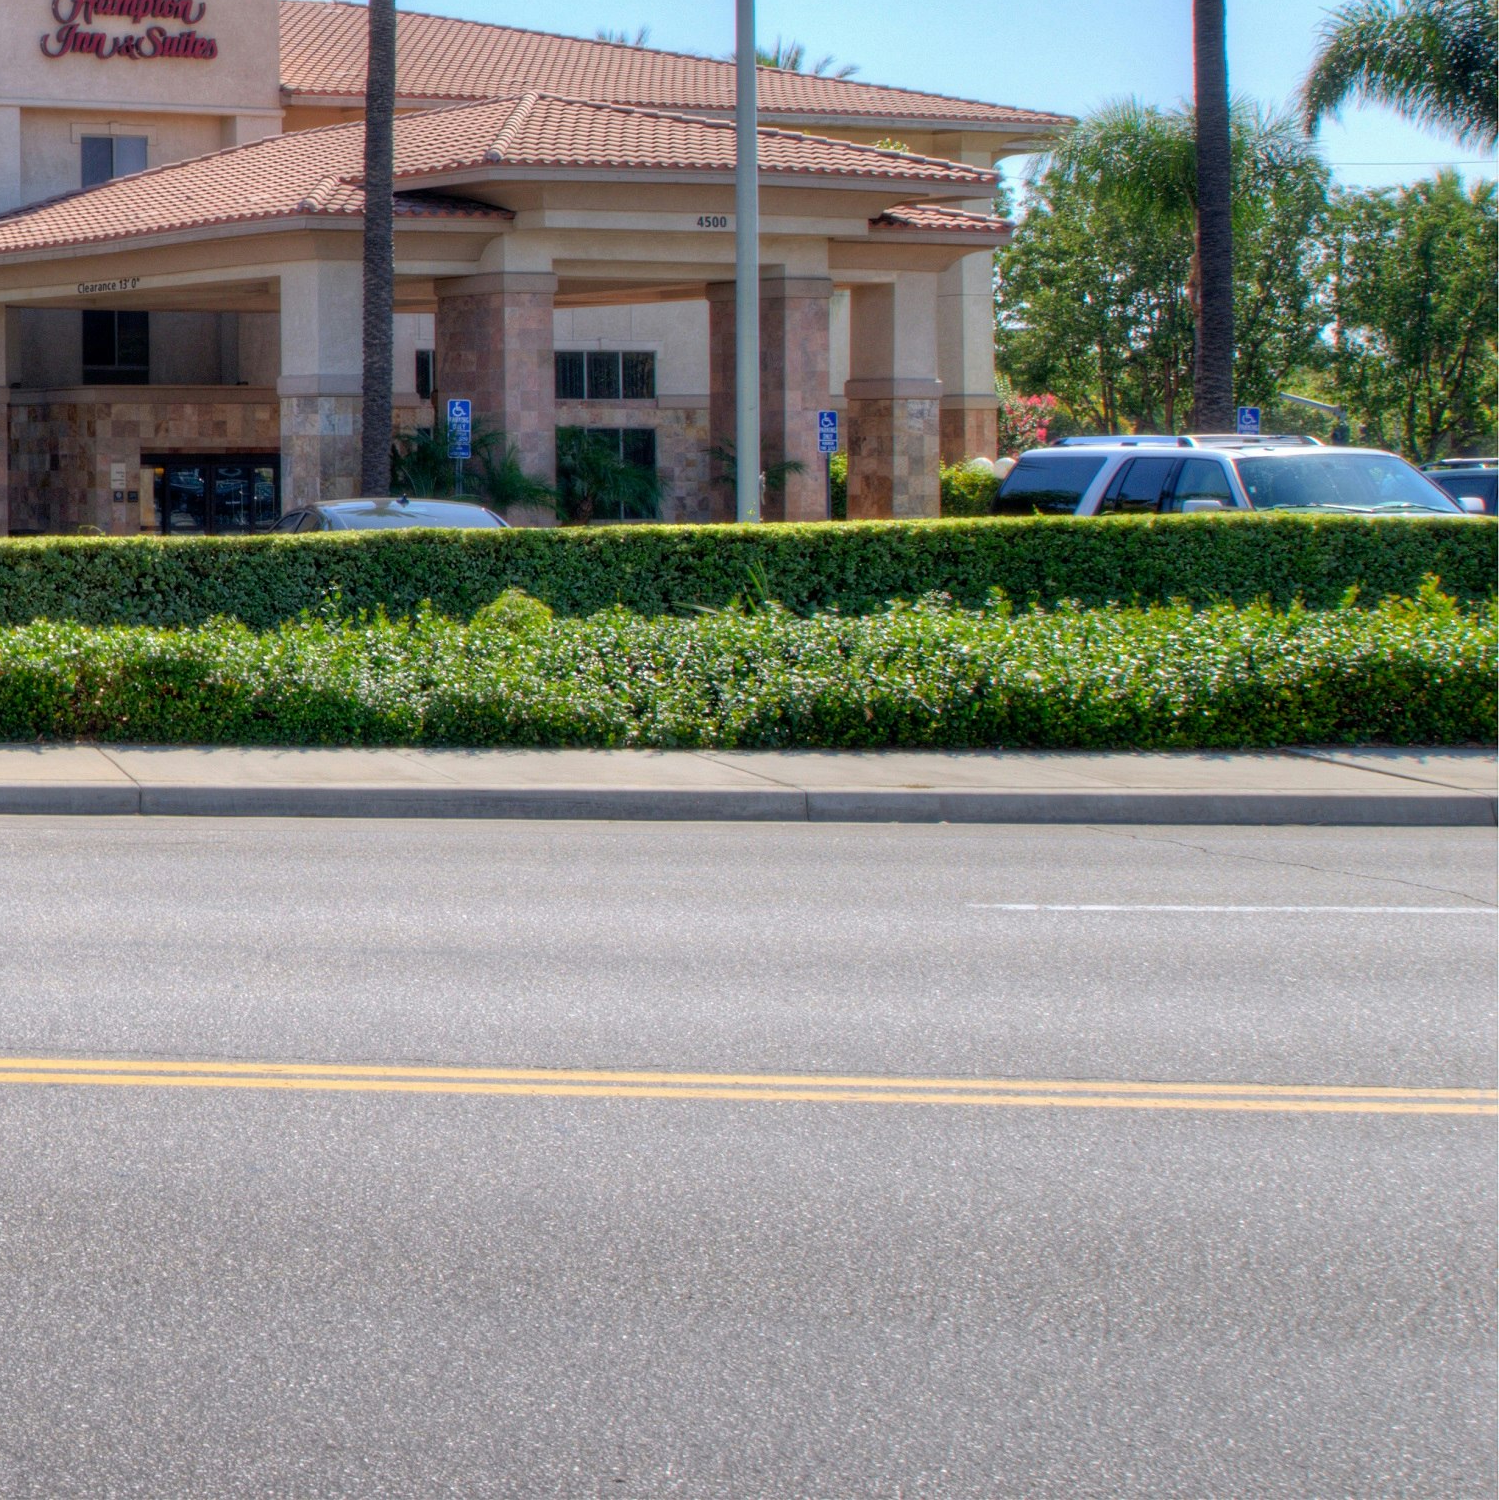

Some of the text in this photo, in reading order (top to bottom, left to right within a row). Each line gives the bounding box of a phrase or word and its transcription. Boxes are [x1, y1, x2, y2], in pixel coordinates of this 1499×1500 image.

[40, 23, 218, 60] Inn & Suites
[696, 215, 727, 228] 4500
[77, 282, 117, 294] Clearance
